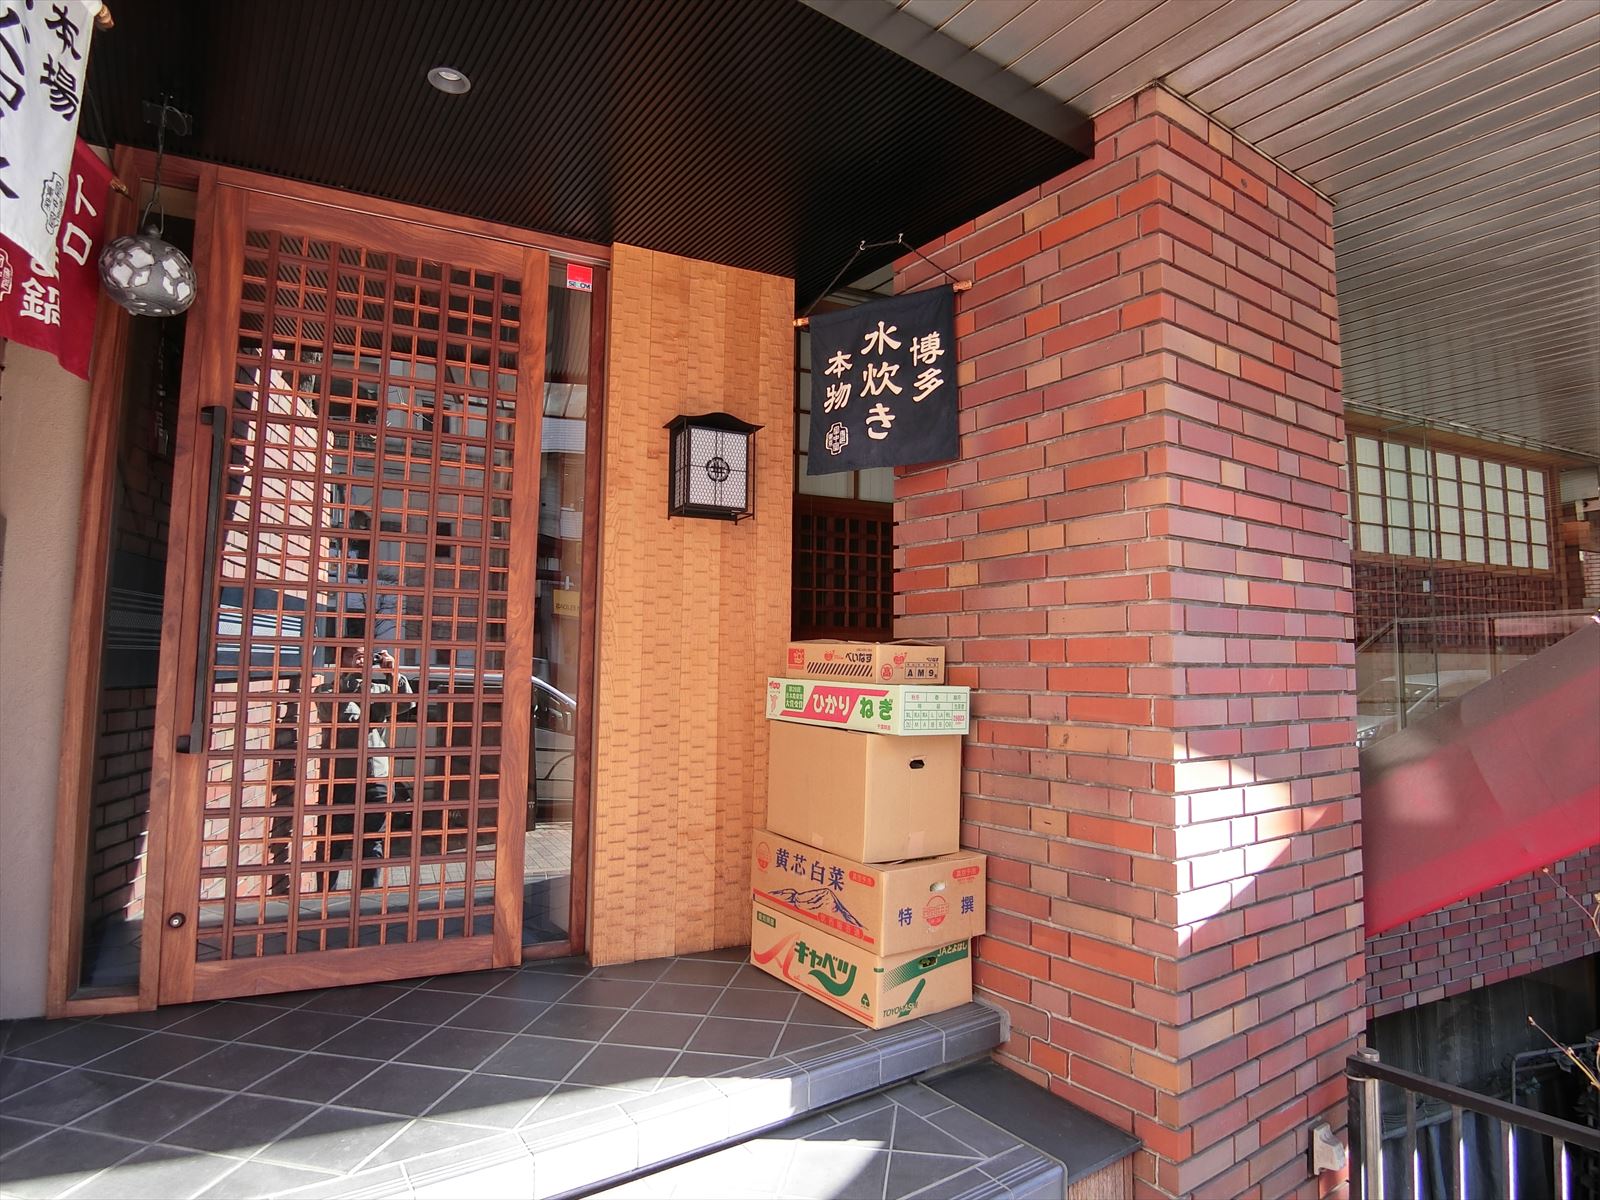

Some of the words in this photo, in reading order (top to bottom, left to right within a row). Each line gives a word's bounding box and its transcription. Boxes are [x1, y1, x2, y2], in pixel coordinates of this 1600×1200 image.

[40, 3, 82, 122] 本場
[823, 350, 853, 414] 本物
[859, 320, 903, 440] 水炊き
[909, 331, 945, 403] 博多
[845, 651, 872, 664] べいなす
[906, 669, 914, 677] A
[917, 669, 925, 677] M
[774, 847, 845, 892] 黄芯白菜
[898, 907, 913, 928] 特
[793, 940, 858, 997] キャベツ
